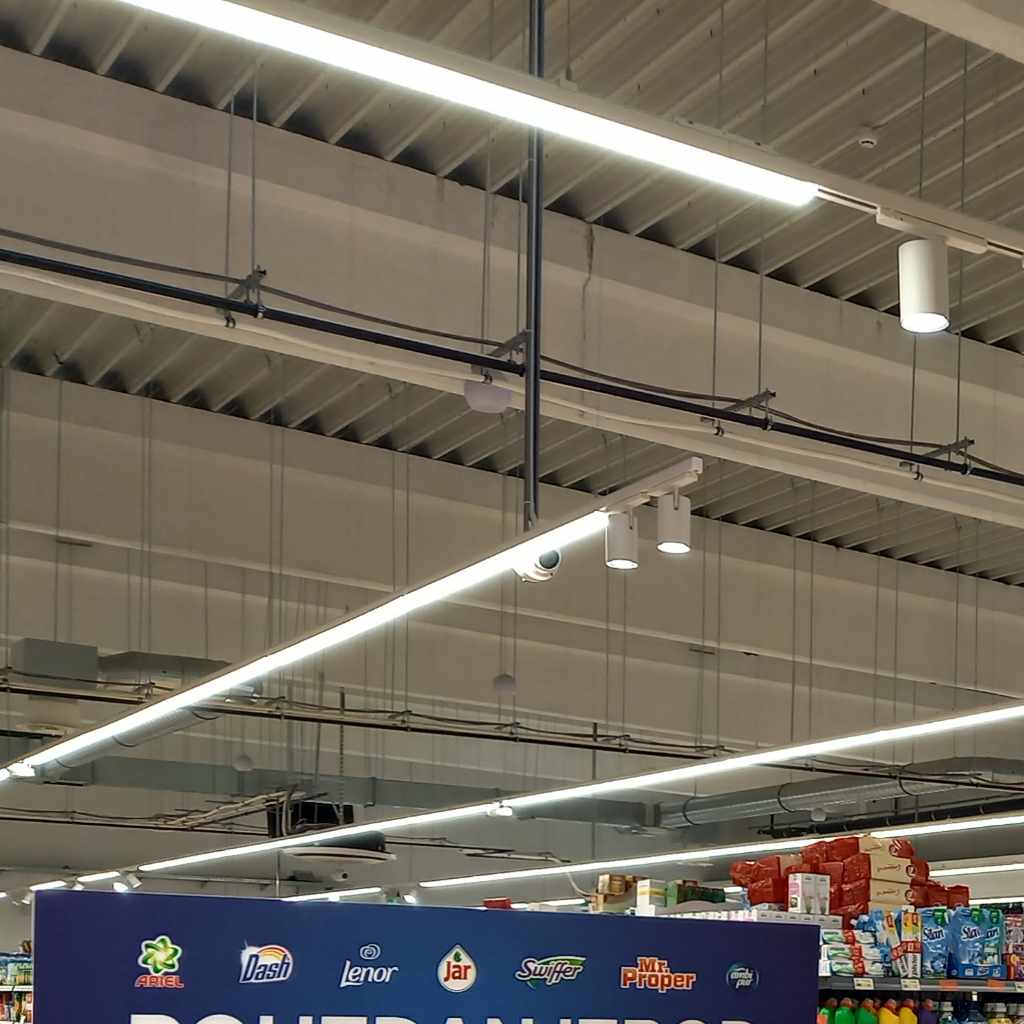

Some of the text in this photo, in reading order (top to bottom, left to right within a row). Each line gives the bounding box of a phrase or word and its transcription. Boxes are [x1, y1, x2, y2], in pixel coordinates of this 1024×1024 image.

[239, 953, 293, 984] Dash
[340, 959, 399, 988] Lenor
[515, 956, 585, 986] Swiffer
[636, 956, 670, 974] Mr.
[134, 974, 184, 989] ARIEL
[620, 966, 697, 993] Proper
